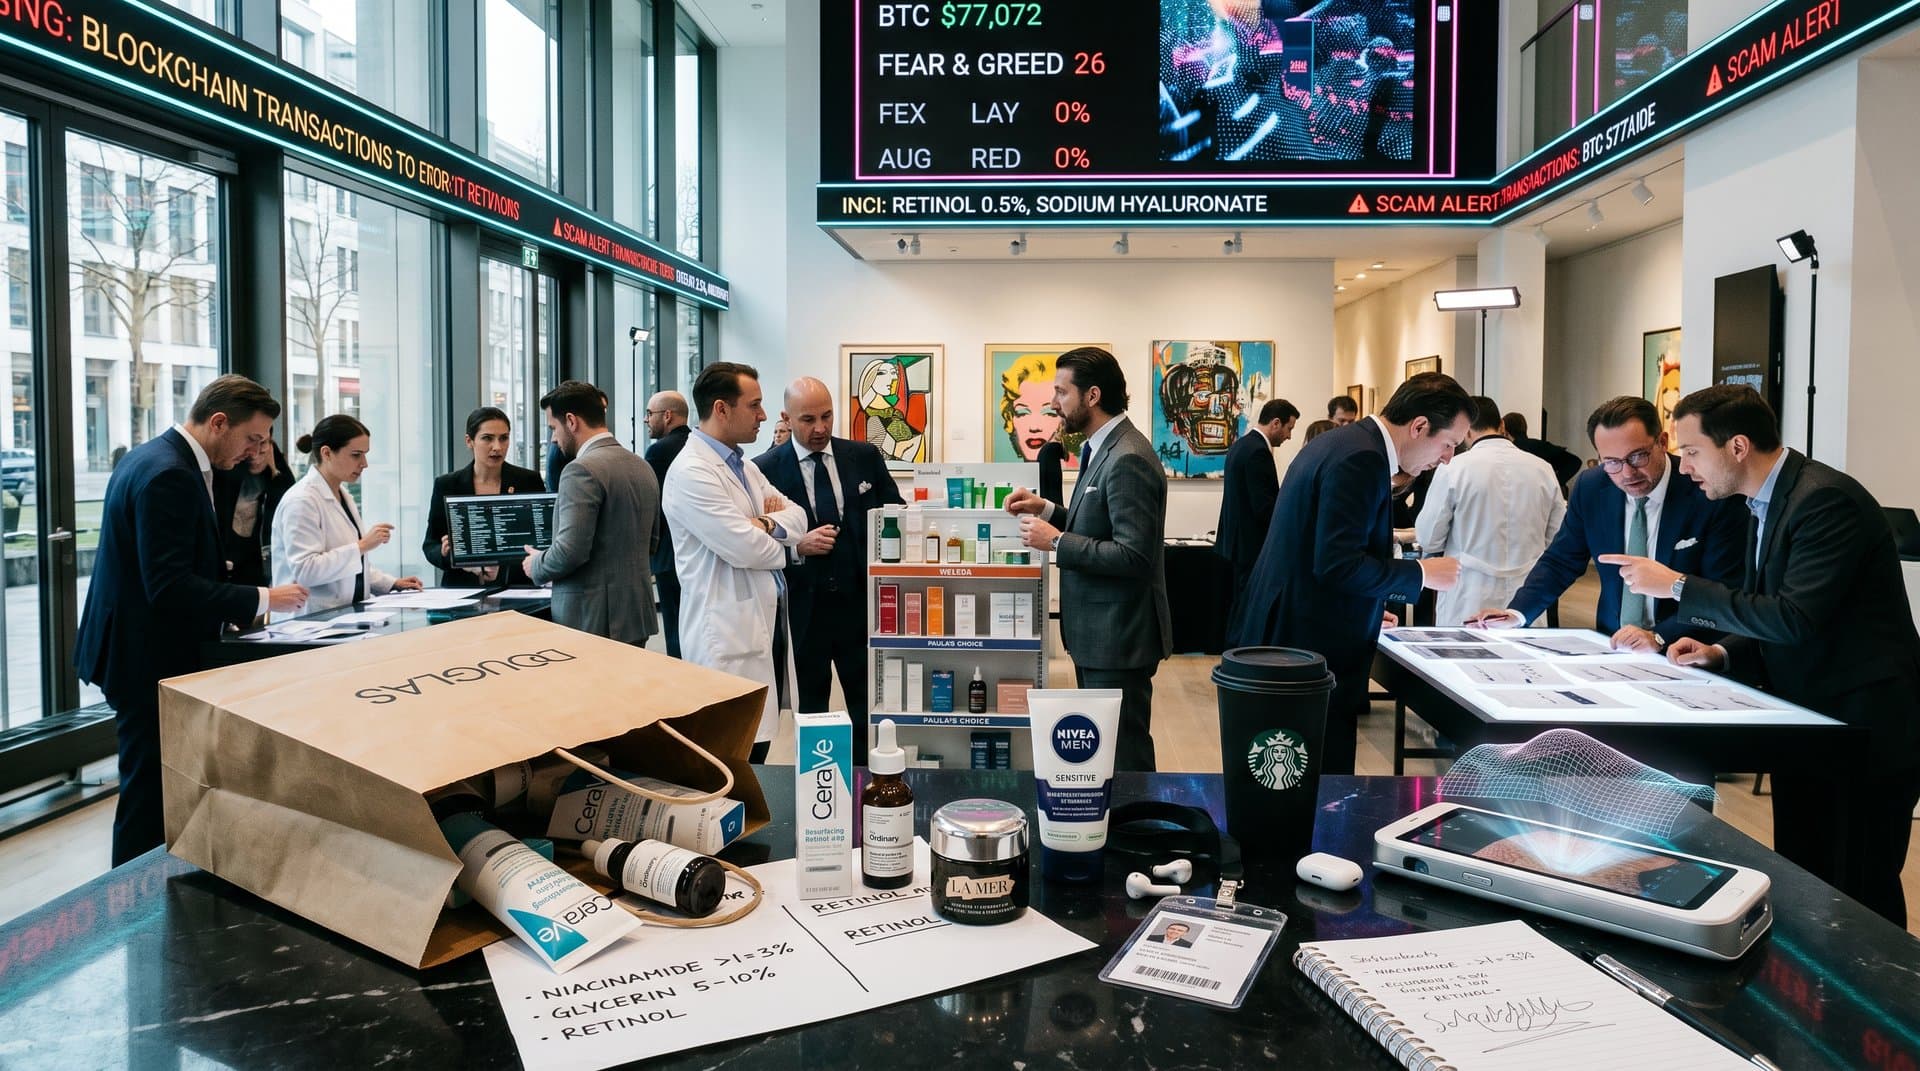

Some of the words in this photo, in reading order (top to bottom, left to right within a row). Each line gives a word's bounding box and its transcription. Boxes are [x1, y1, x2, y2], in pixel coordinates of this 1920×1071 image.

[878, 4, 930, 28] BTC
[941, 1, 1042, 29] $77,072
[1727, 31, 1777, 83] SCAM
[1780, 0, 1842, 56] ALERT
[878, 53, 945, 76] FEAR
[952, 53, 970, 75] &
[977, 52, 1064, 75] GREED
[1074, 52, 1106, 74] 26
[82, 14, 248, 113] BLOCKCHAIN
[253, 88, 393, 171] TRANSACTIONS
[396, 150, 416, 179] TO
[878, 103, 927, 124] FEX
[971, 102, 1020, 124] LAY
[1055, 101, 1090, 123] 0%
[878, 149, 932, 169] AUG
[971, 148, 1021, 169] RED
[1055, 147, 1090, 168] 0%
[1376, 195, 1435, 213] SCAM
[1440, 192, 1500, 213] ALERT
[1582, 132, 1604, 163] BTC
[842, 197, 887, 214] INCI:
[892, 196, 976, 213] RETINOL
[981, 196, 1031, 216] 0.5%,
[1036, 196, 1115, 213] SODIUM
[1120, 195, 1268, 213] HYALURONATE
[563, 222, 587, 247] SCAM
[587, 234, 611, 255] ALERT
[939, 568, 972, 576] WELEDA
[927, 640, 955, 648] PAULA'S
[956, 640, 984, 648] CHOICE
[355, 648, 577, 704] DOUGLAS
[922, 717, 958, 725] PAULA'S
[959, 717, 990, 725] CHOICE
[1056, 729, 1096, 740] NIVEA
[1061, 740, 1092, 750] MEN
[811, 739, 833, 820] CeraVe
[1055, 774, 1097, 782] SENSITIVE
[575, 774, 607, 834] CeraV
[869, 833, 899, 843] Ordinary
[952, 879, 971, 895] LA
[975, 880, 1008, 896] MER
[811, 889, 908, 914] RETINOL
[536, 895, 613, 944] CeraVe
[844, 915, 942, 940] RETINOL
[542, 961, 703, 1000] NIACINAMIDE
[551, 986, 677, 1020] GLYCERIN
[561, 1008, 688, 1041] RETINOL
